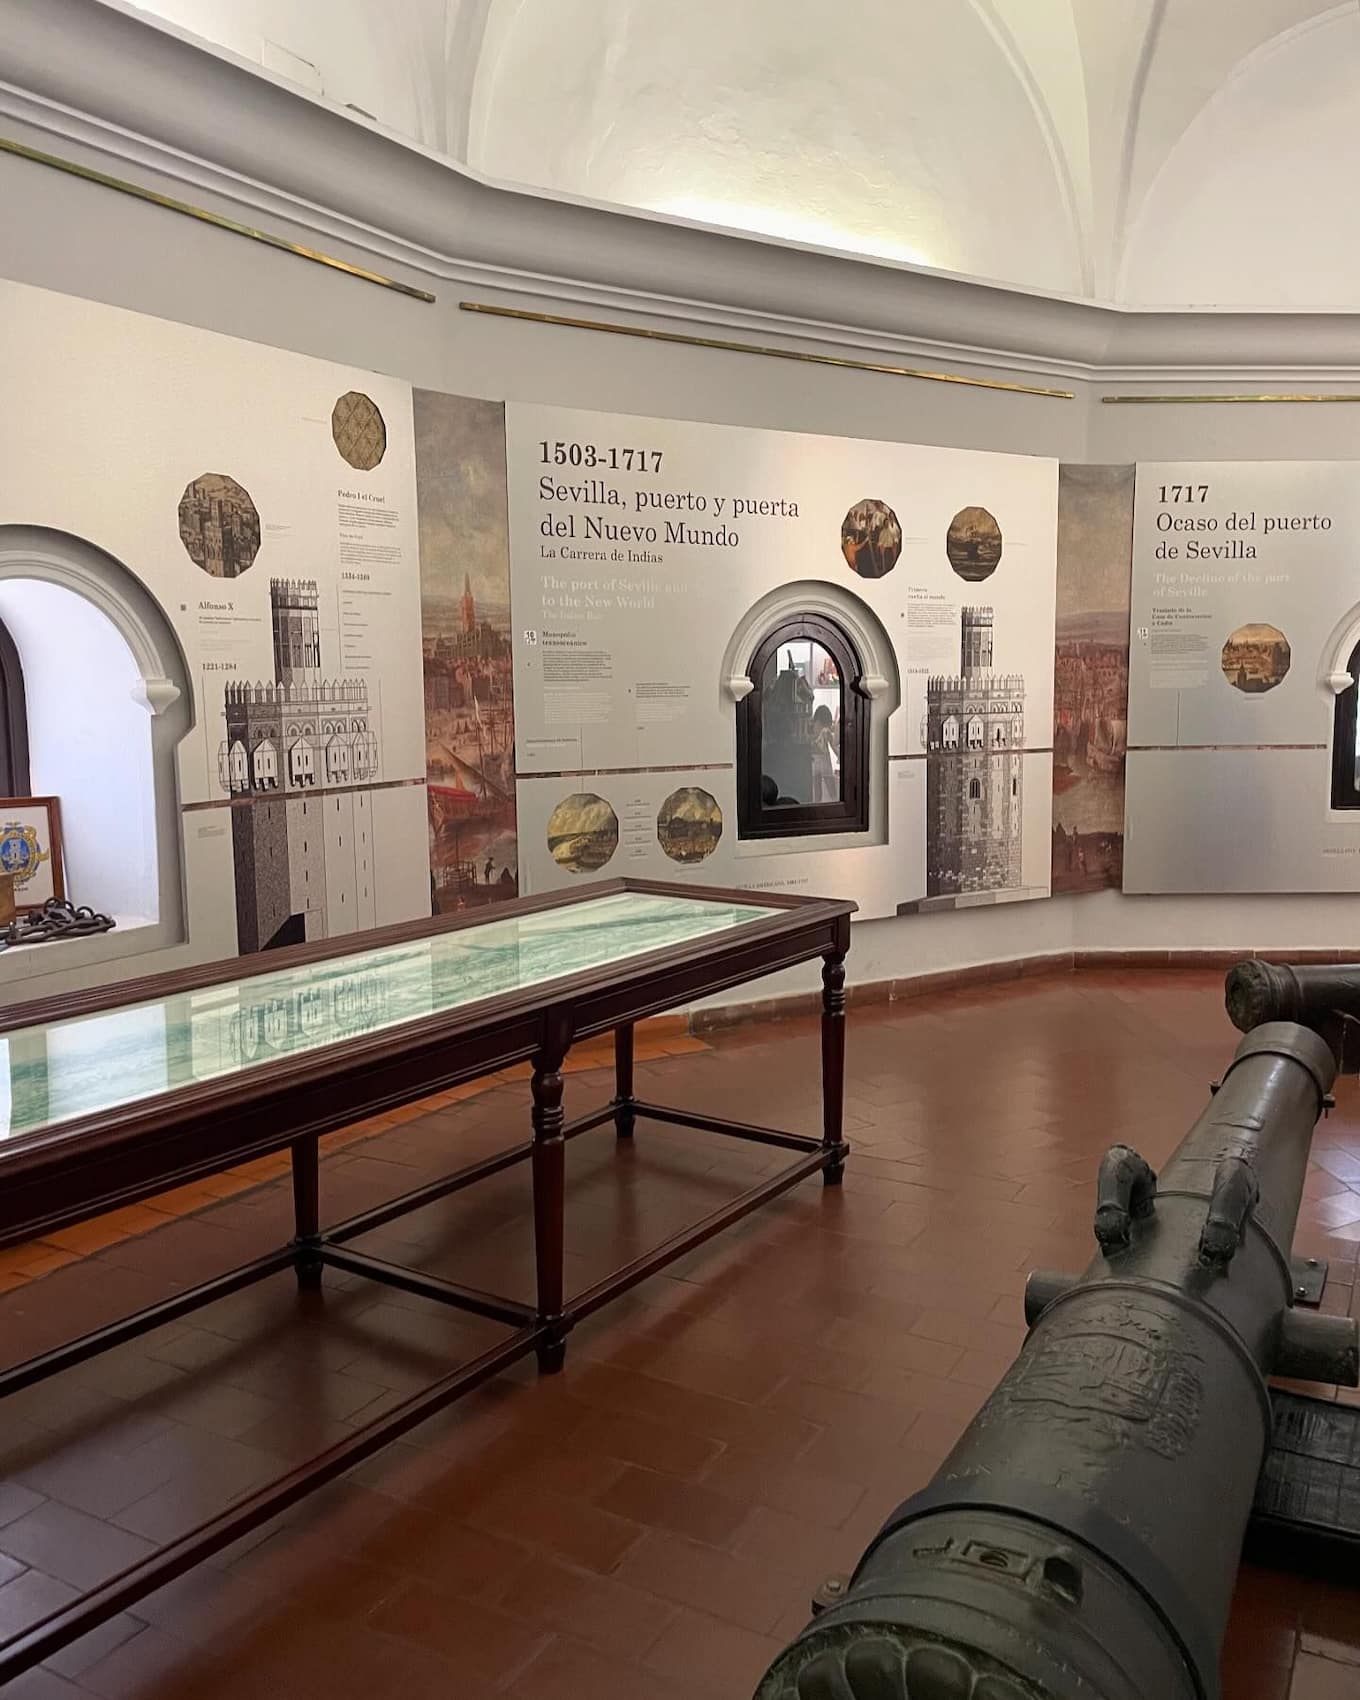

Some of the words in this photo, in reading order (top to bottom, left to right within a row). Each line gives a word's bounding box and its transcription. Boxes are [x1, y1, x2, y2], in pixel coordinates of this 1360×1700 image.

[539, 441, 663, 473] 1503-1717
[539, 476, 627, 509] Sevilla,
[635, 490, 707, 511] puerto
[713, 496, 726, 517] y
[732, 497, 799, 518] puerta
[1158, 485, 1209, 503] 1717
[540, 513, 577, 538] del
[584, 516, 657, 542] Nuevo
[664, 521, 739, 547] Mundo
[1156, 512, 1218, 532] Ocaso
[1225, 512, 1256, 531] del
[1263, 515, 1332, 534] puerto
[540, 545, 556, 559] La
[560, 546, 607, 561] Carrera
[610, 548, 625, 562] de
[628, 549, 663, 563] Indias
[1155, 541, 1179, 560] de
[1186, 540, 1257, 560] Sevilla
[541, 575, 567, 589] The
[571, 578, 599, 592] port
[542, 595, 555, 607] to
[559, 594, 582, 607] the
[584, 595, 613, 608] New
[615, 596, 655, 609] World
